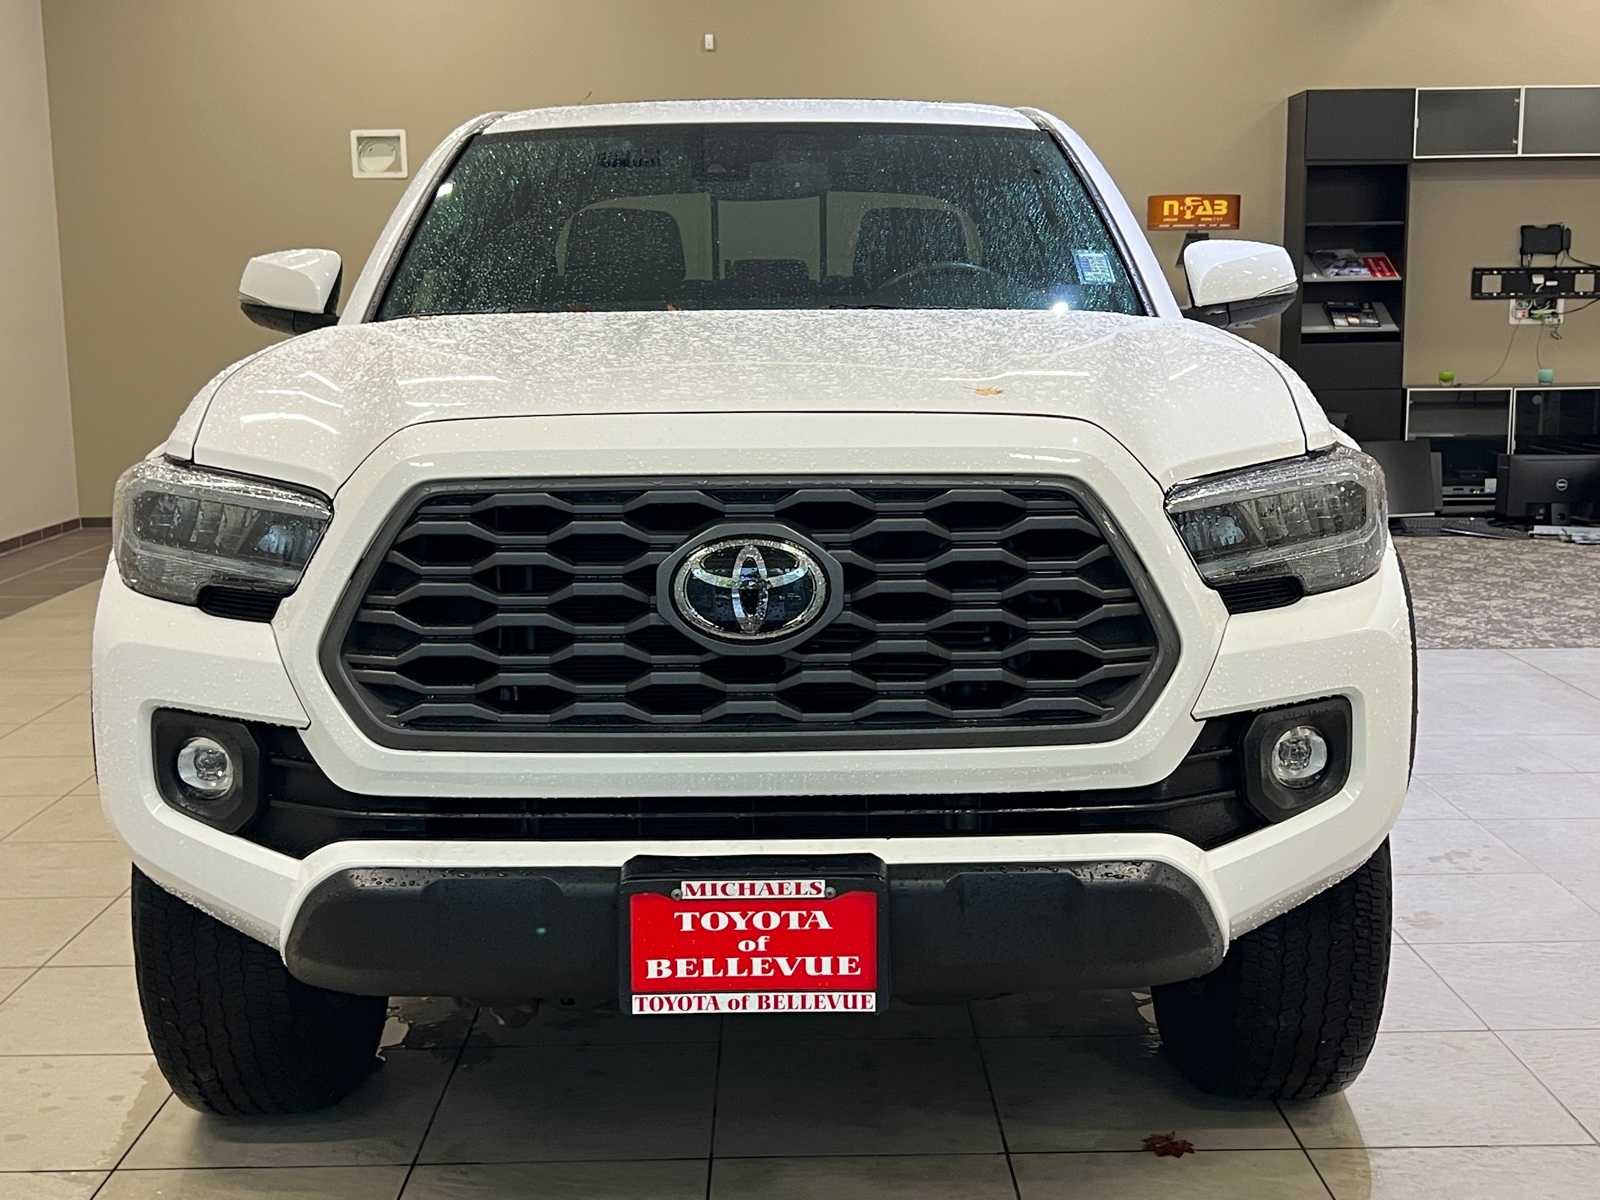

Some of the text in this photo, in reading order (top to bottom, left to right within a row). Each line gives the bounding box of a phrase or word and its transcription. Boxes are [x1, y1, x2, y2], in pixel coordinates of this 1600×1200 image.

[684, 881, 823, 897] MICHAELS
[674, 910, 832, 932] TOYOTA
[737, 935, 770, 952] of
[645, 956, 861, 979] BELLEVUE
[634, 993, 874, 1012] TOYOTA of BELLEVUE
